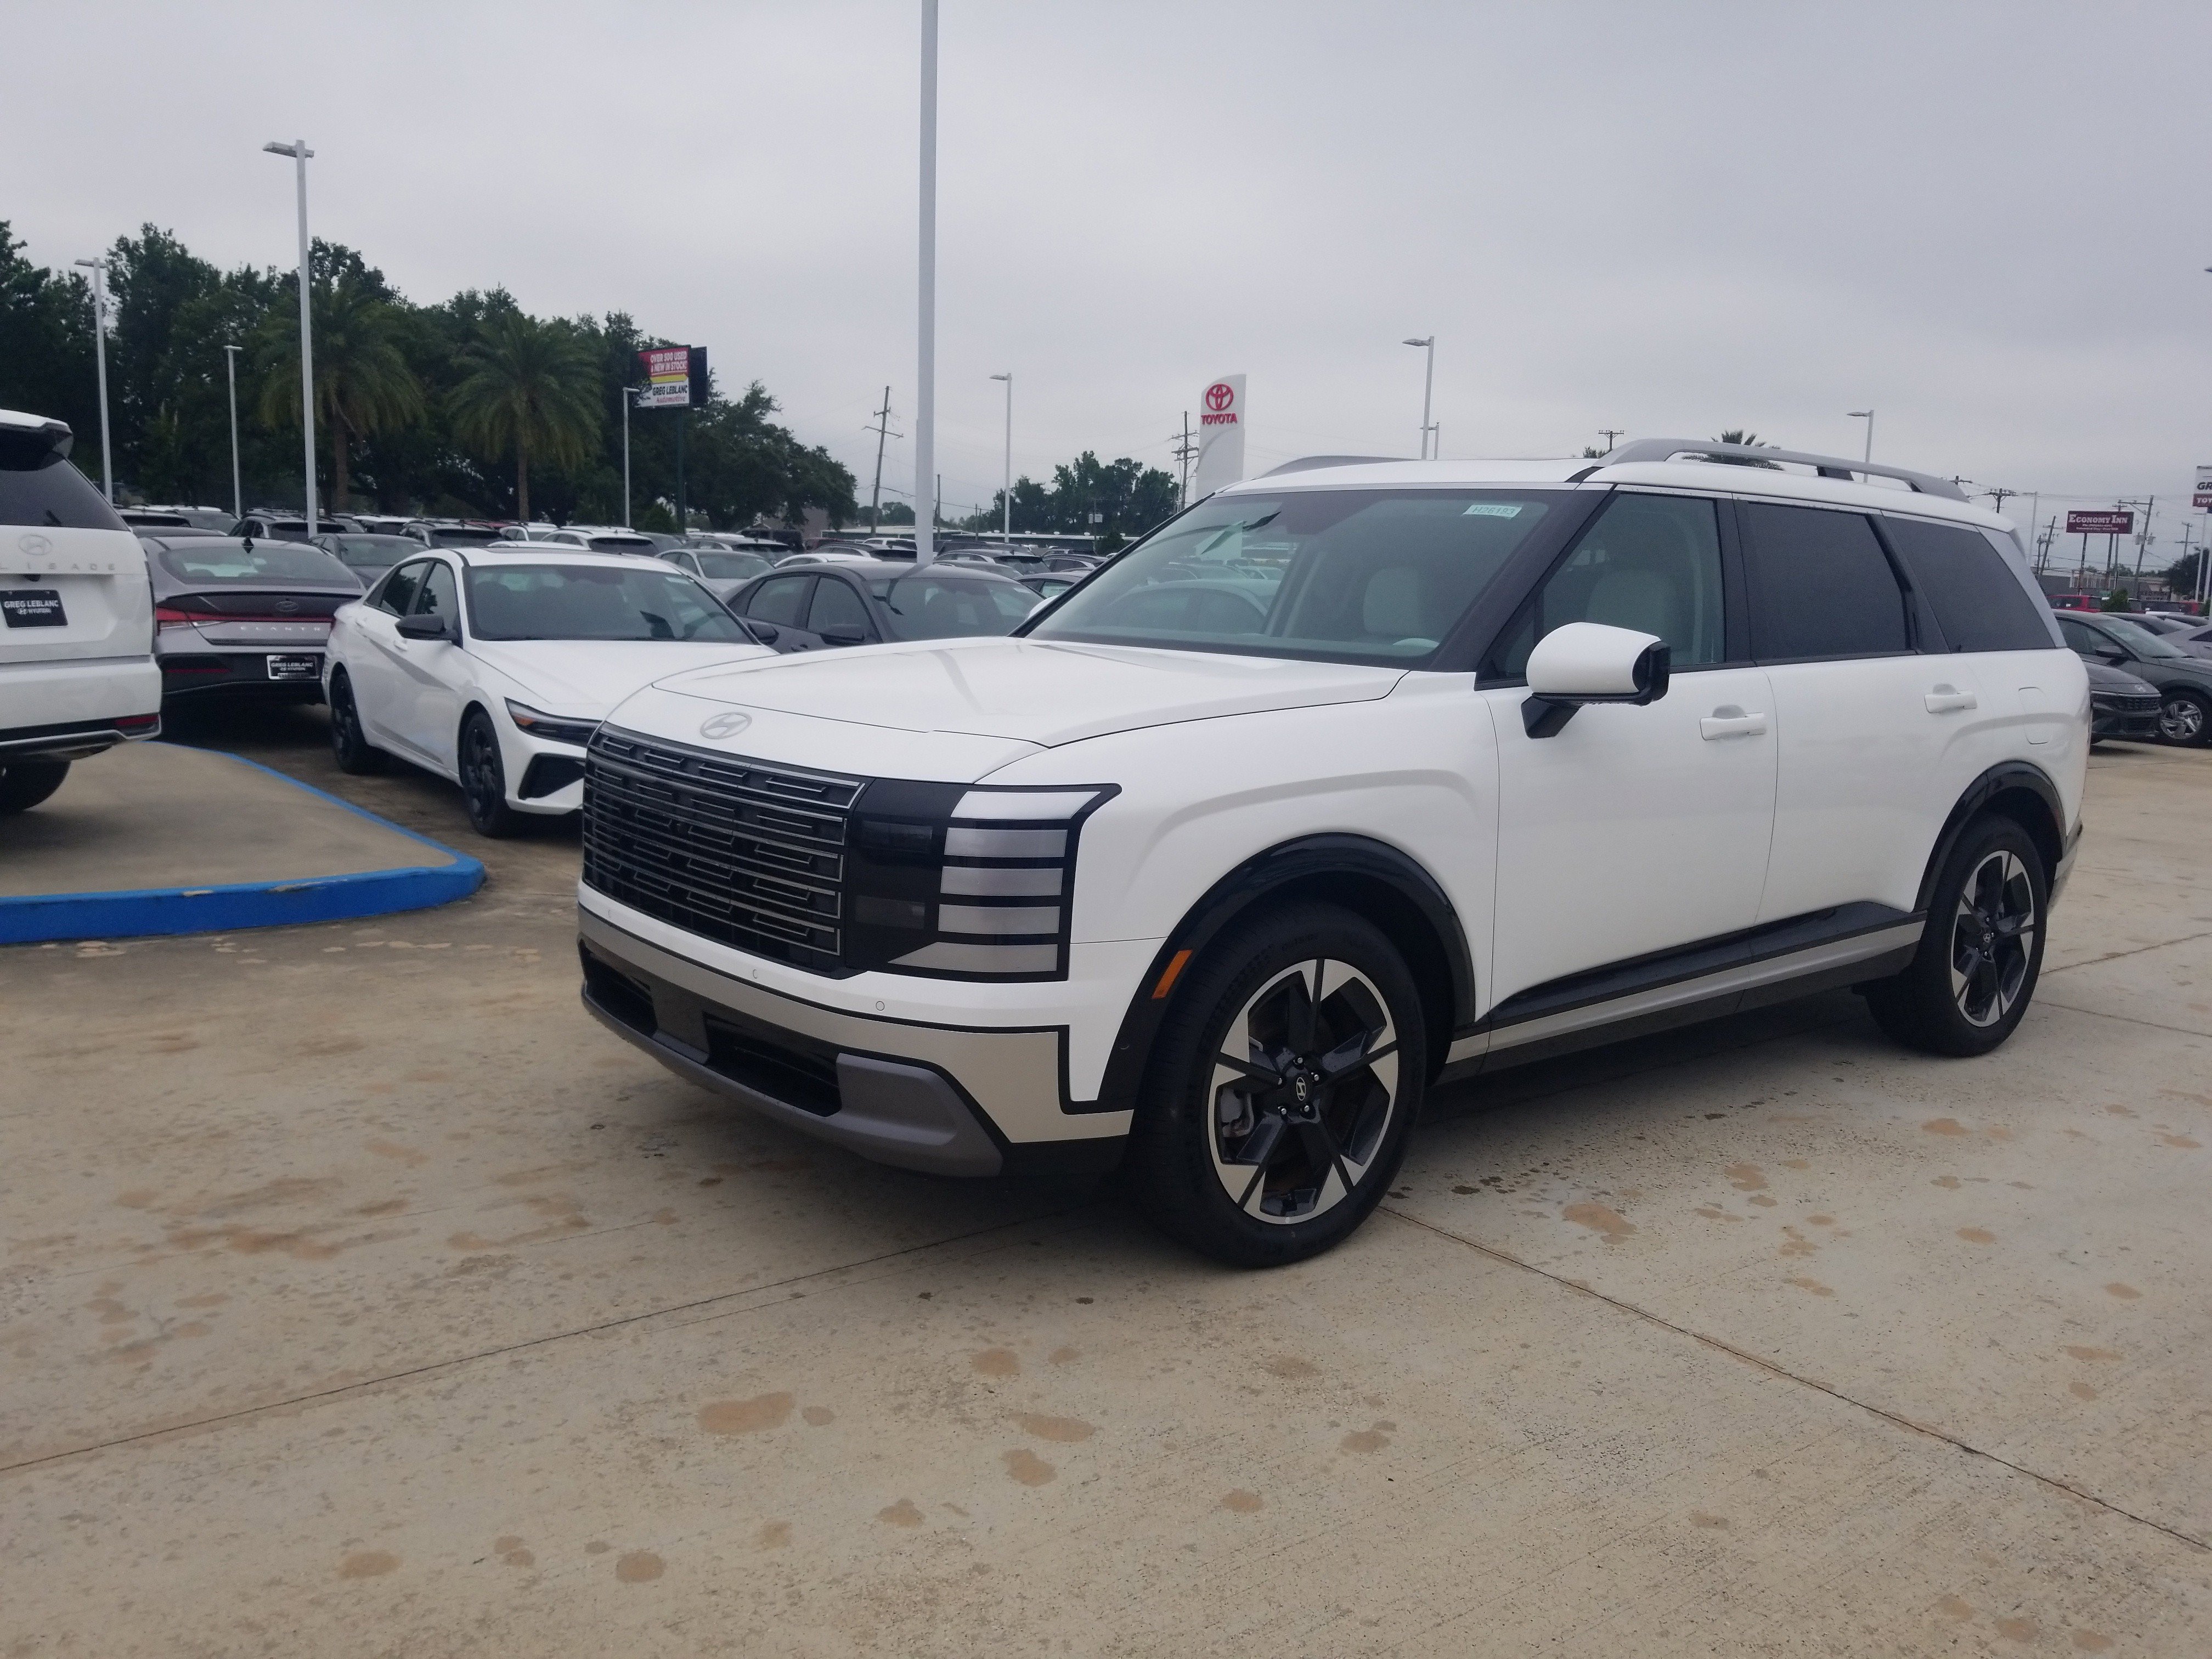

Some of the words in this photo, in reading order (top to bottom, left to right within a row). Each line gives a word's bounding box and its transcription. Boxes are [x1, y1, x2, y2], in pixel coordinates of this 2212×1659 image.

[653, 386, 665, 396] GREG
[666, 385, 687, 394] LEBLANC
[1200, 413, 1238, 425] TOYOTA
